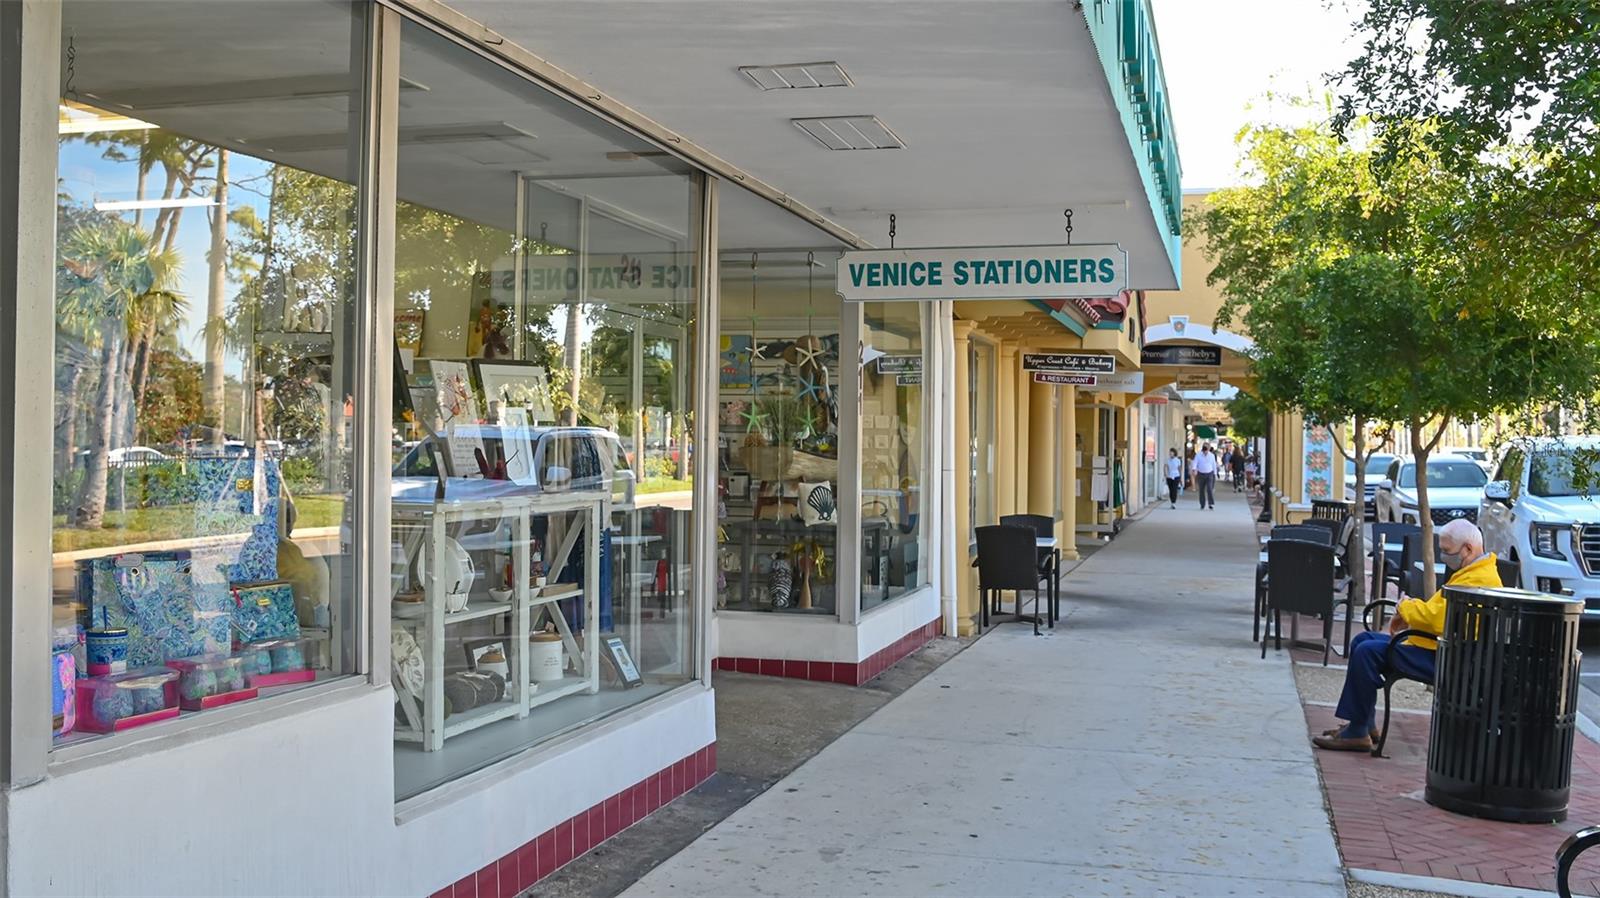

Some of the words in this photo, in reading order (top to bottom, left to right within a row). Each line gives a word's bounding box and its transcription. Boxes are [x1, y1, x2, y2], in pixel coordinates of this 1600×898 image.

[849, 261, 942, 287] VENICE
[953, 258, 1115, 286] STATIONERS
[1025, 355, 1045, 366] Upper
[1088, 357, 1112, 368] Bakery
[1047, 375, 1089, 383] RESTAURANT
